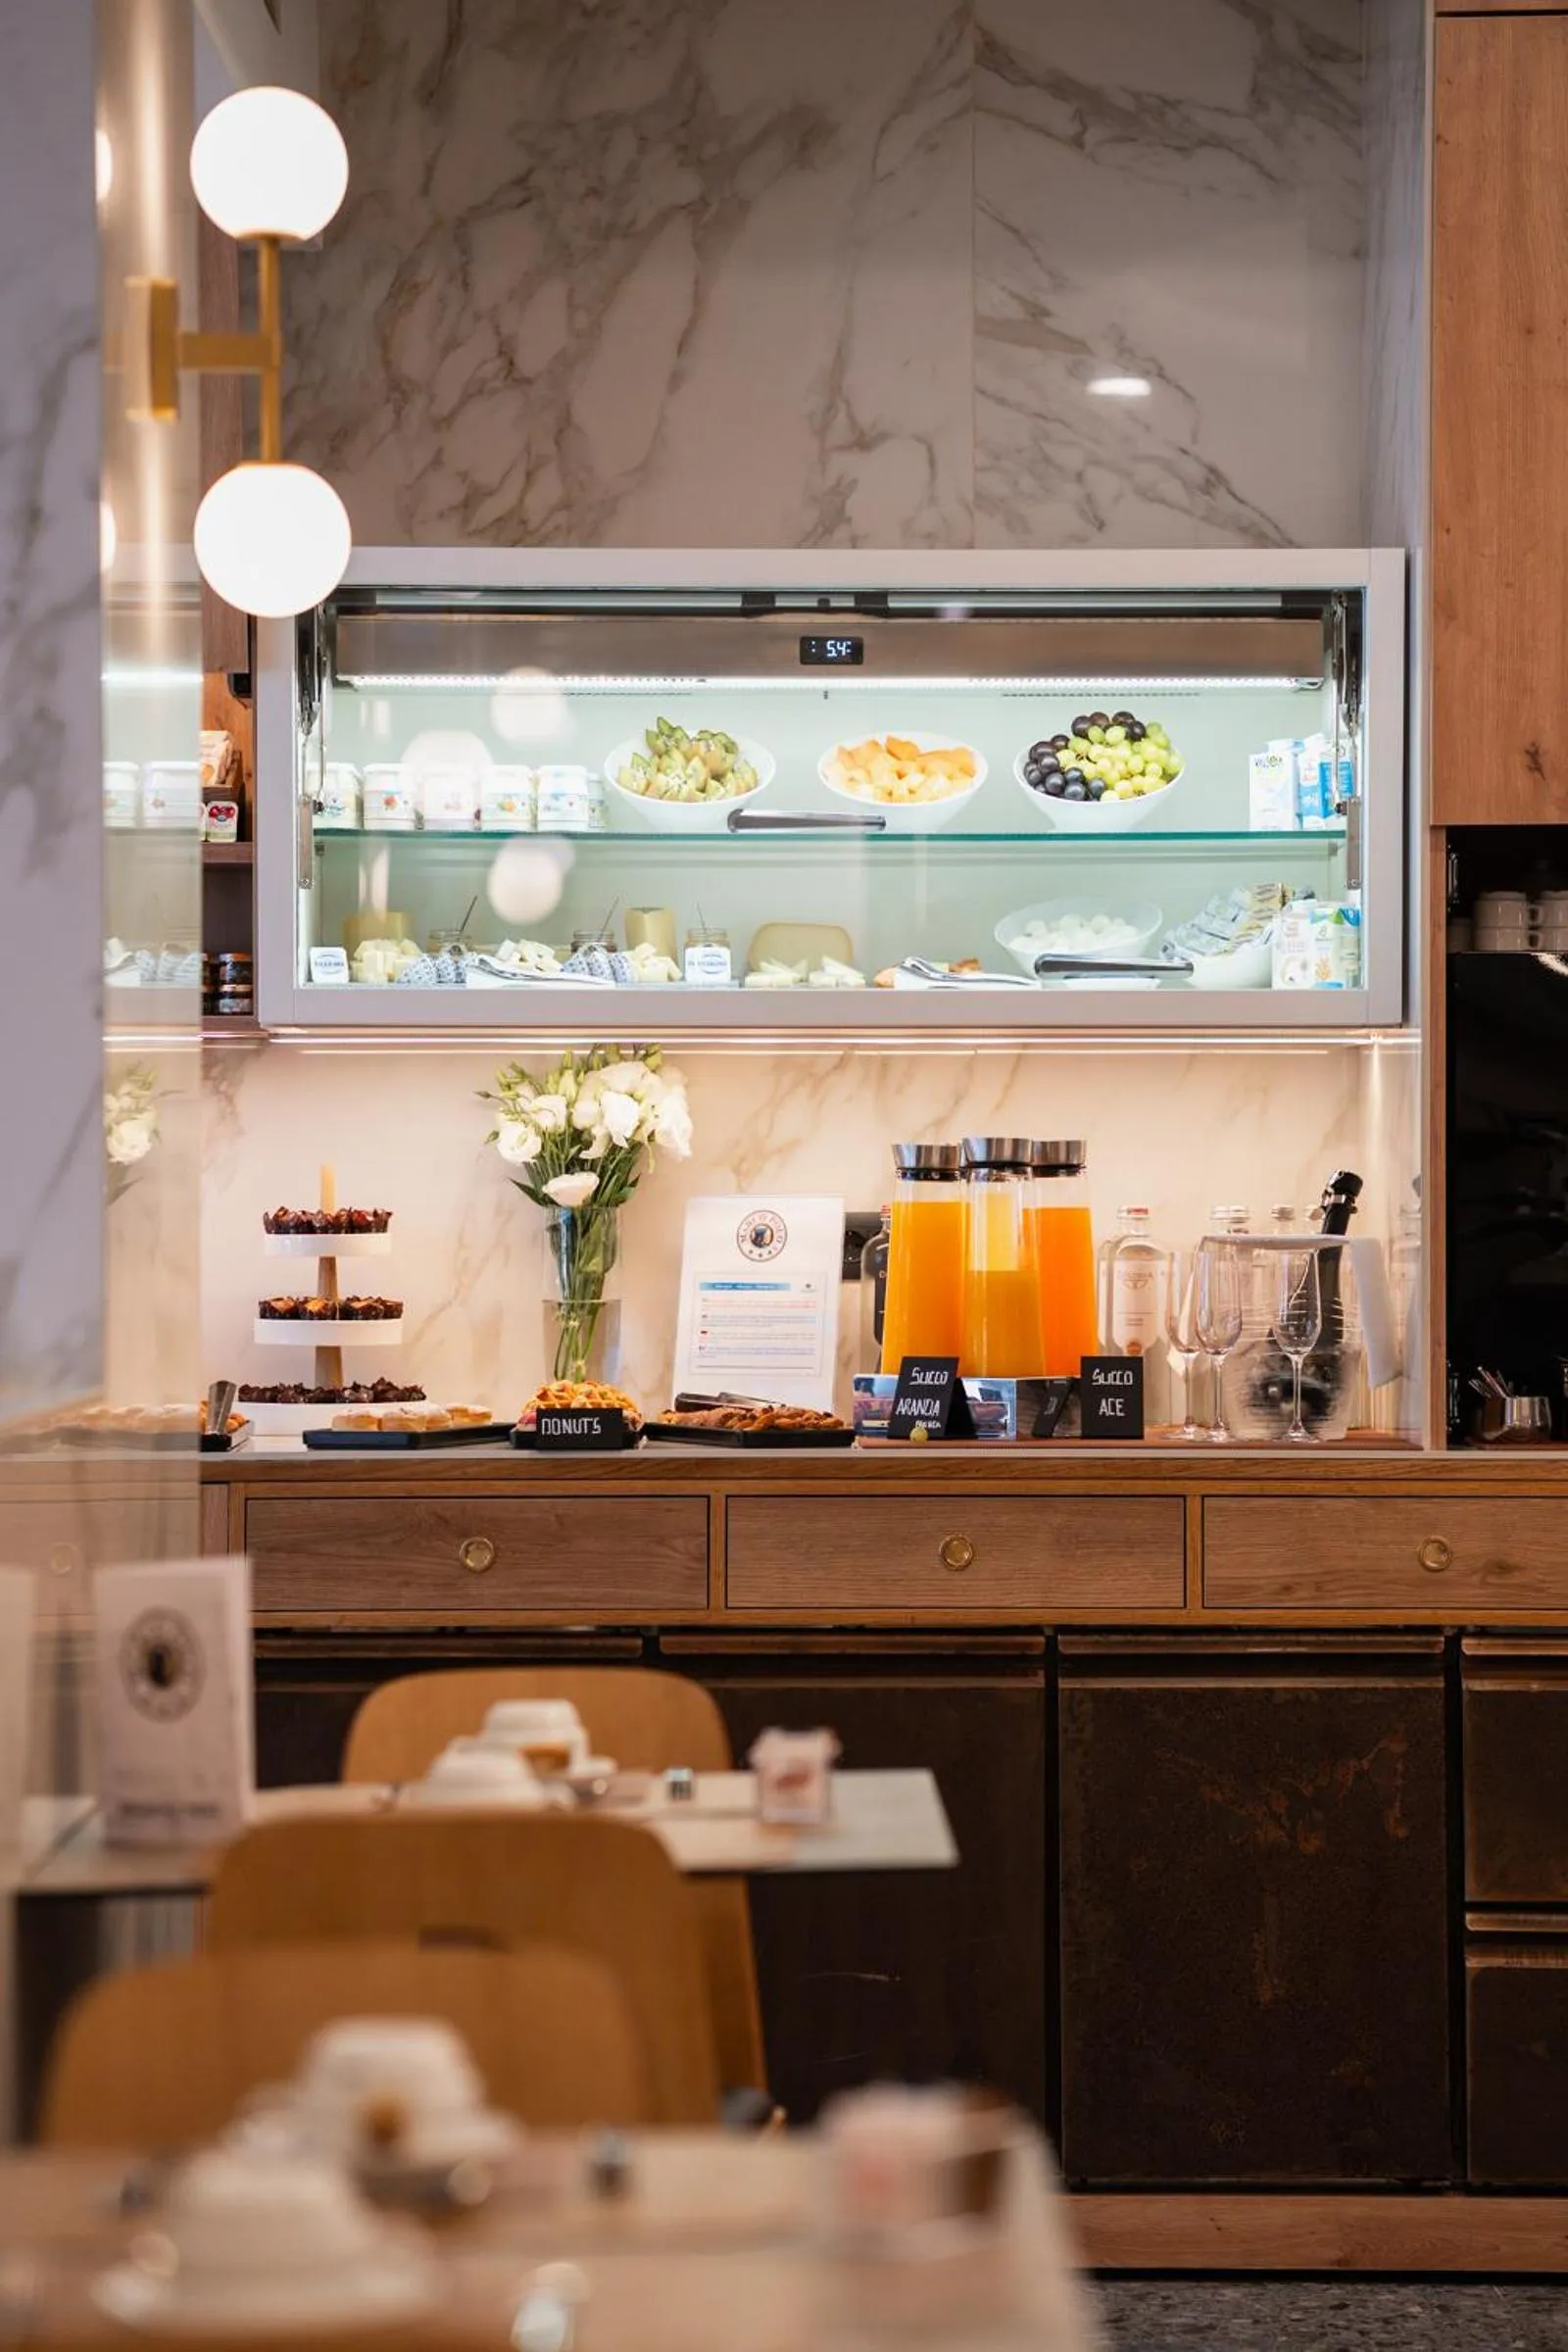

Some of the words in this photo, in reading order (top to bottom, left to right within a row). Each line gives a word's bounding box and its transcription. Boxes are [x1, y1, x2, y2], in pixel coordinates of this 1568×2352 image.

[1092, 1368, 1133, 1386] SUCCO
[1099, 1397, 1125, 1416] ACE
[541, 1418, 602, 1435] DONUTS
